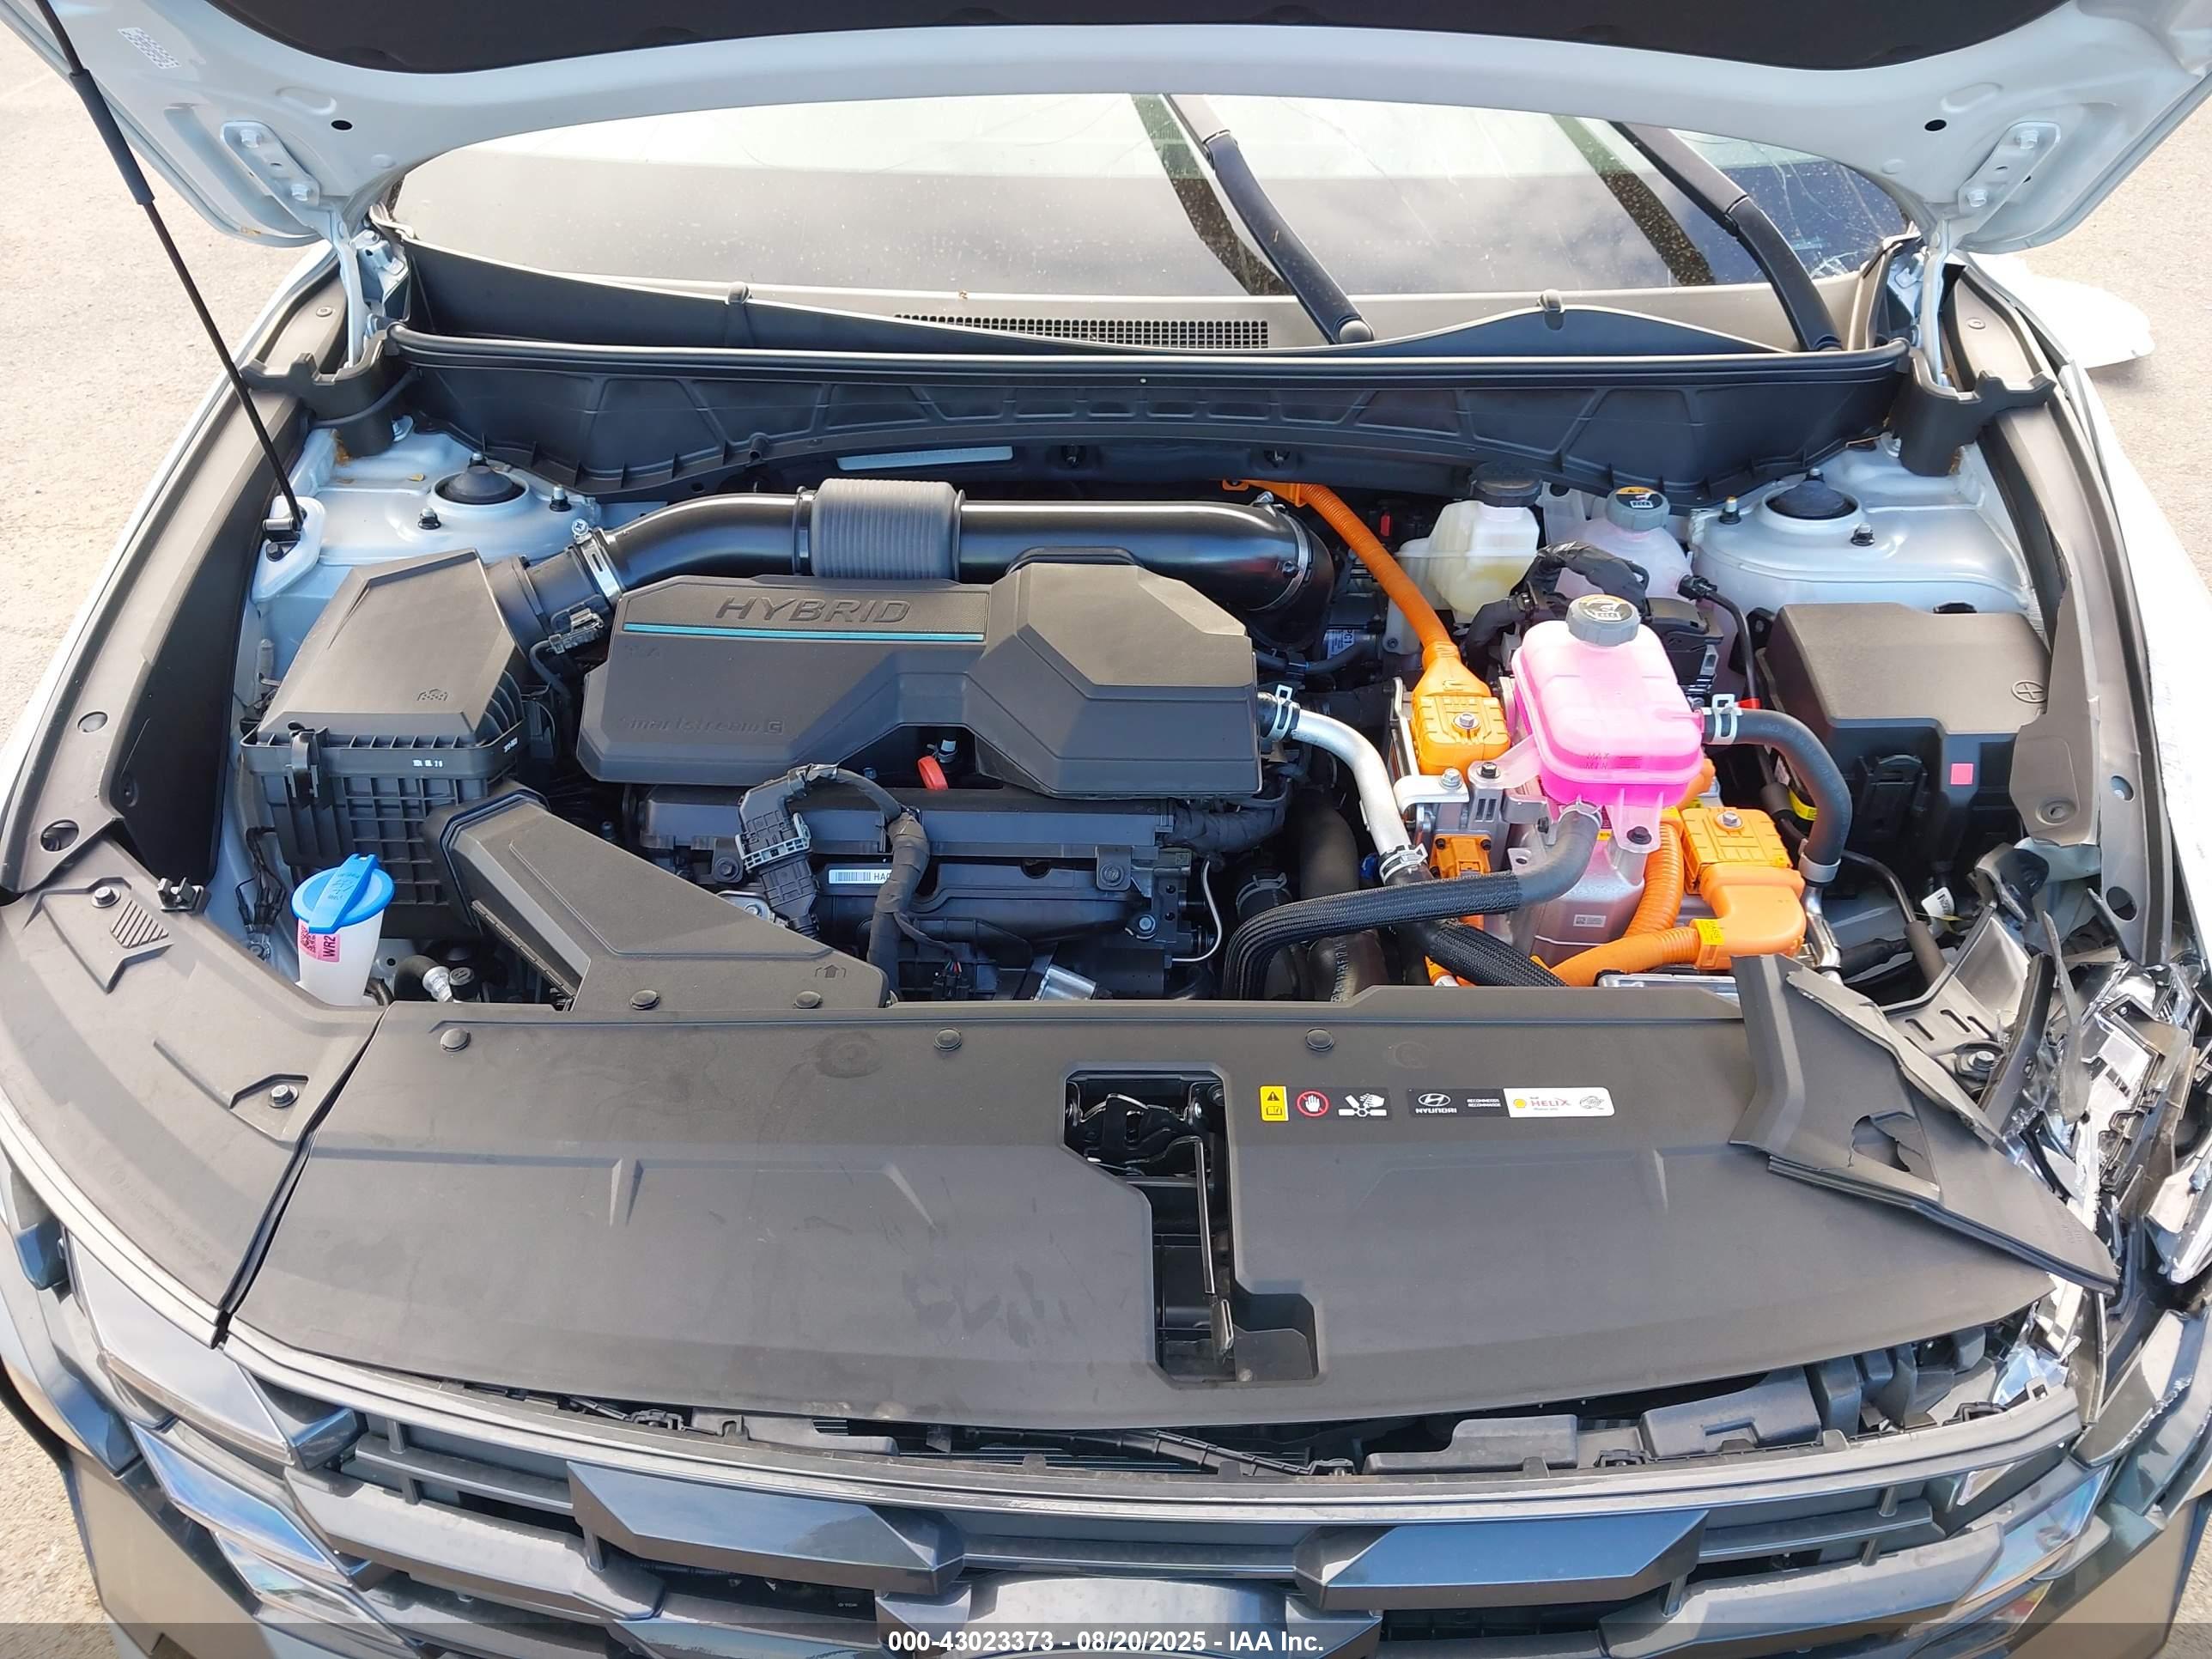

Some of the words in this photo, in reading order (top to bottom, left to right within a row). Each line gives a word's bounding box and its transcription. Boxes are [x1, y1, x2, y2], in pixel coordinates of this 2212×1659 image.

[715, 595, 912, 624] HYBRID
[322, 935, 337, 957] WR2
[1530, 1097, 1571, 1107] HELIX
